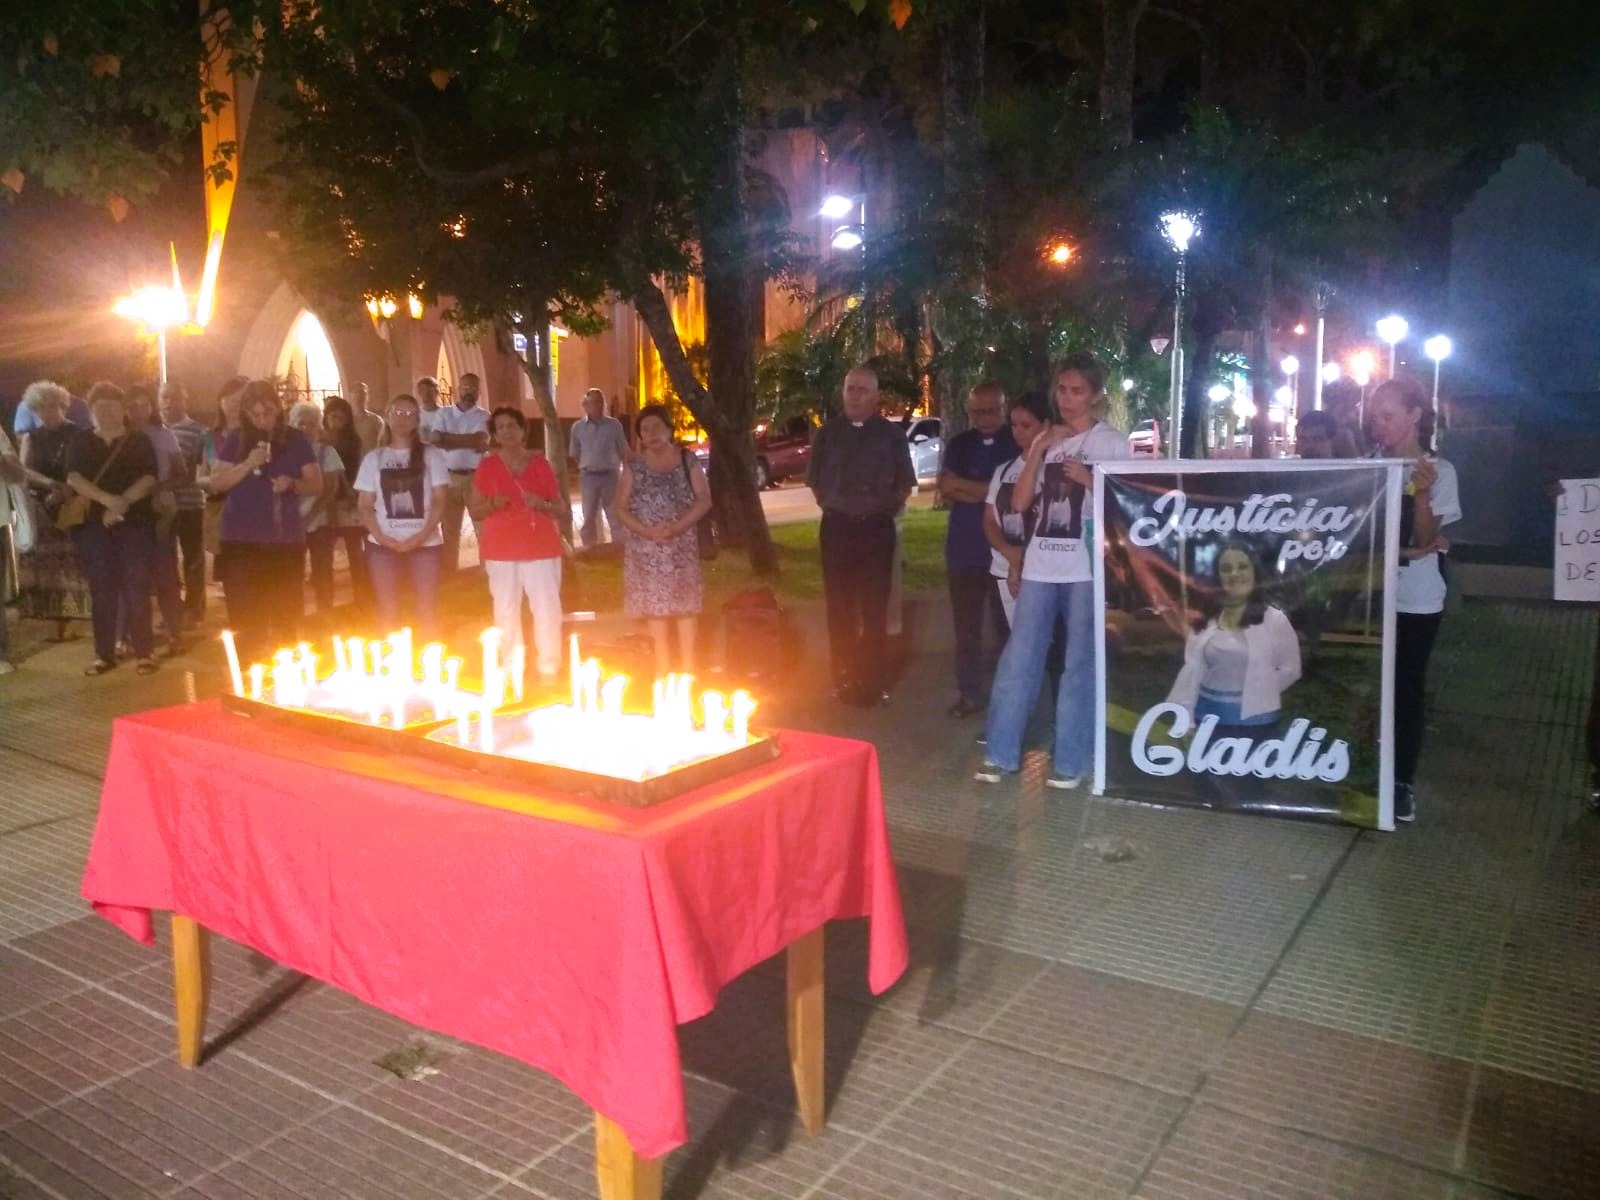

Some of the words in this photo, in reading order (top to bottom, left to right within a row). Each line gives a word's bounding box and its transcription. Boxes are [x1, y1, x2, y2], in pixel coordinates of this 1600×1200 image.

[1130, 489, 1353, 546] Justicia
[1038, 540, 1078, 552] Gomez
[1277, 536, 1349, 574] por
[1131, 702, 1350, 782] Gladis
